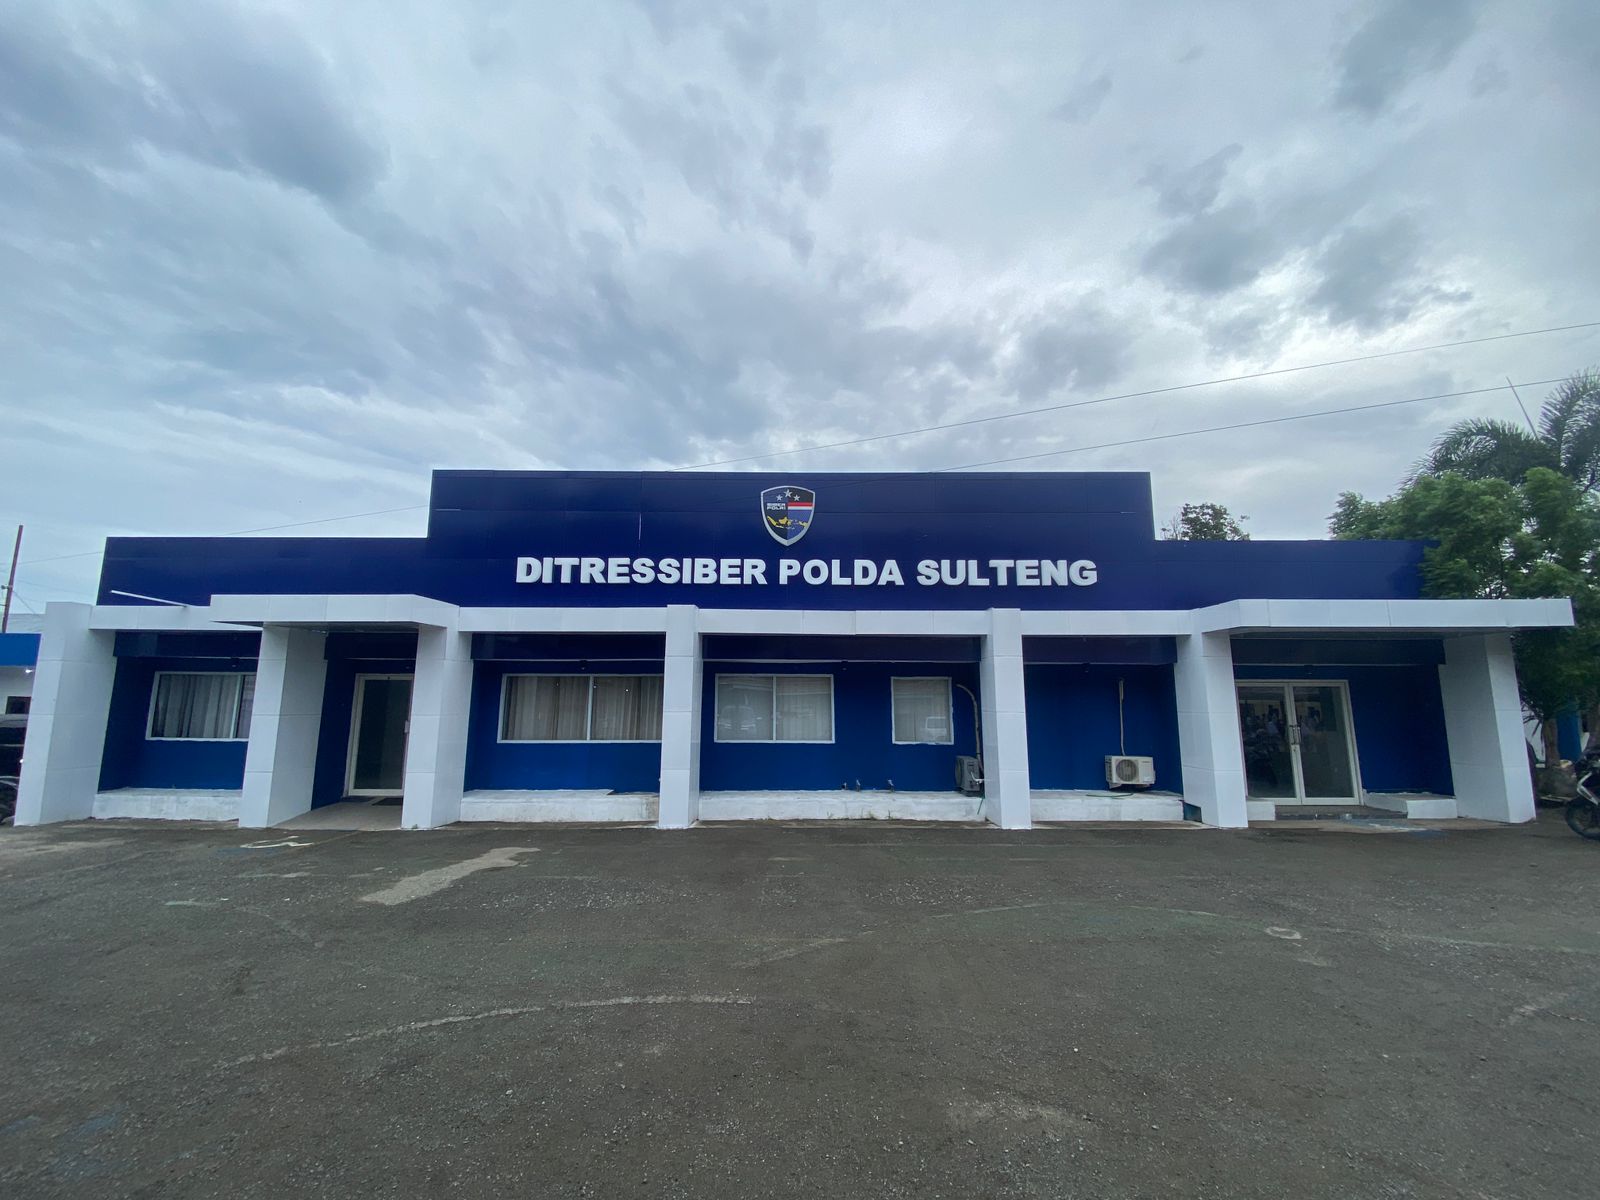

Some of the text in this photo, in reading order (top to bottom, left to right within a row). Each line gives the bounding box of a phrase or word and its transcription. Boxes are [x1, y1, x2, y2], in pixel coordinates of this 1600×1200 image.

[515, 556, 1098, 586] DITRESSIBER POLDA SULTENG
